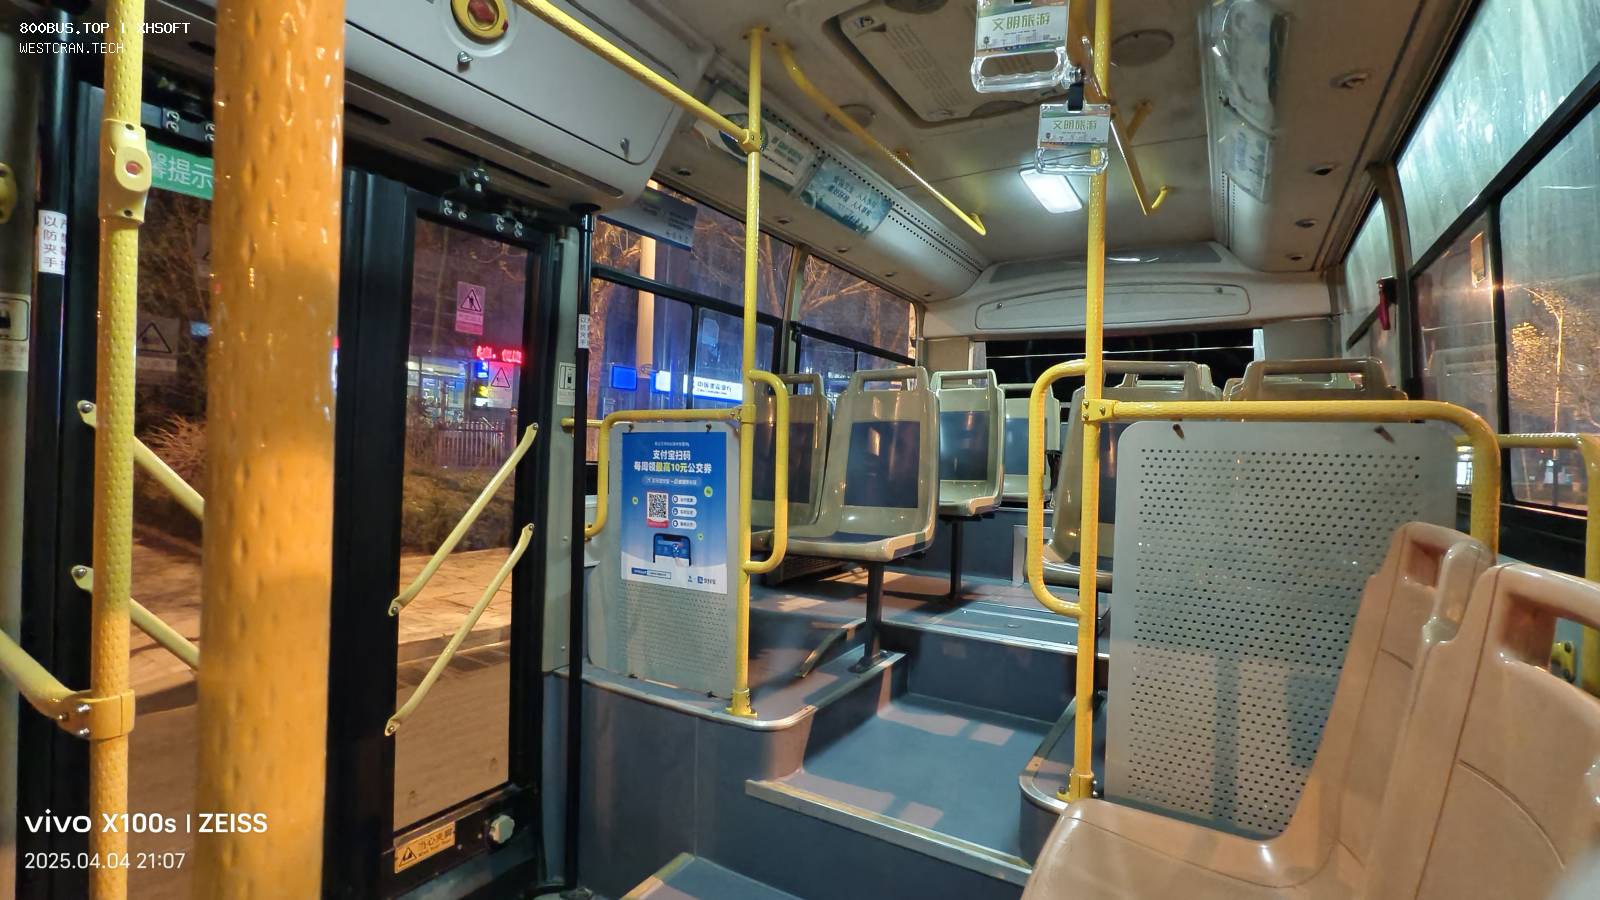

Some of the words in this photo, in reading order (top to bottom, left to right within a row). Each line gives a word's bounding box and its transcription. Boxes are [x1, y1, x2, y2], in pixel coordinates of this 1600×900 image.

[992, 12, 1050, 32] 文明旅游
[1052, 119, 1097, 131] 文明旅游
[43, 215, 58, 268] 以防夹手
[652, 449, 691, 461] 支付宝扫码
[634, 460, 712, 474] 每周领最高10元公交券
